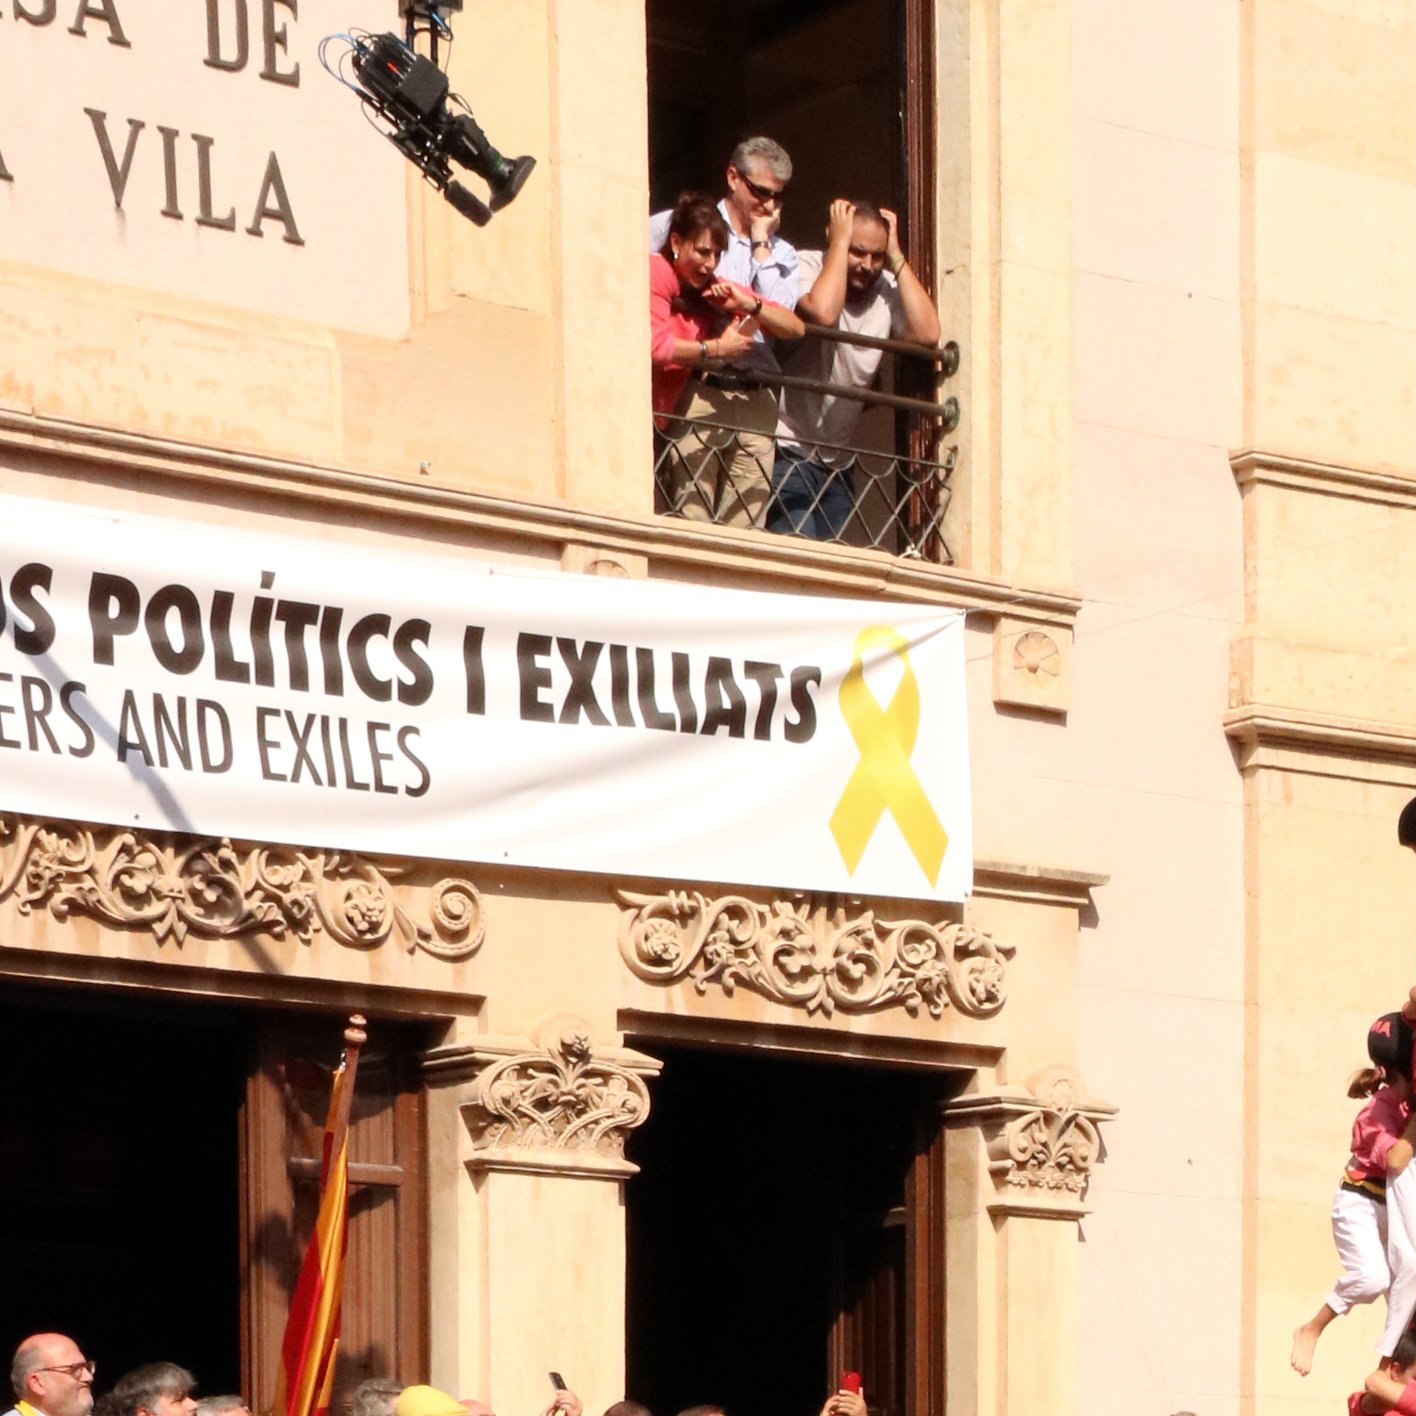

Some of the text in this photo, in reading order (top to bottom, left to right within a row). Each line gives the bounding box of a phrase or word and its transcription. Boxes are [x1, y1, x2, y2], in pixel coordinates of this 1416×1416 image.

[203, 0, 301, 88] DE
[83, 106, 305, 246] VILA
[0, 562, 823, 745] S POLÍTICS I EXILIATS
[118, 689, 234, 775] AND
[256, 706, 432, 798] EXILES
